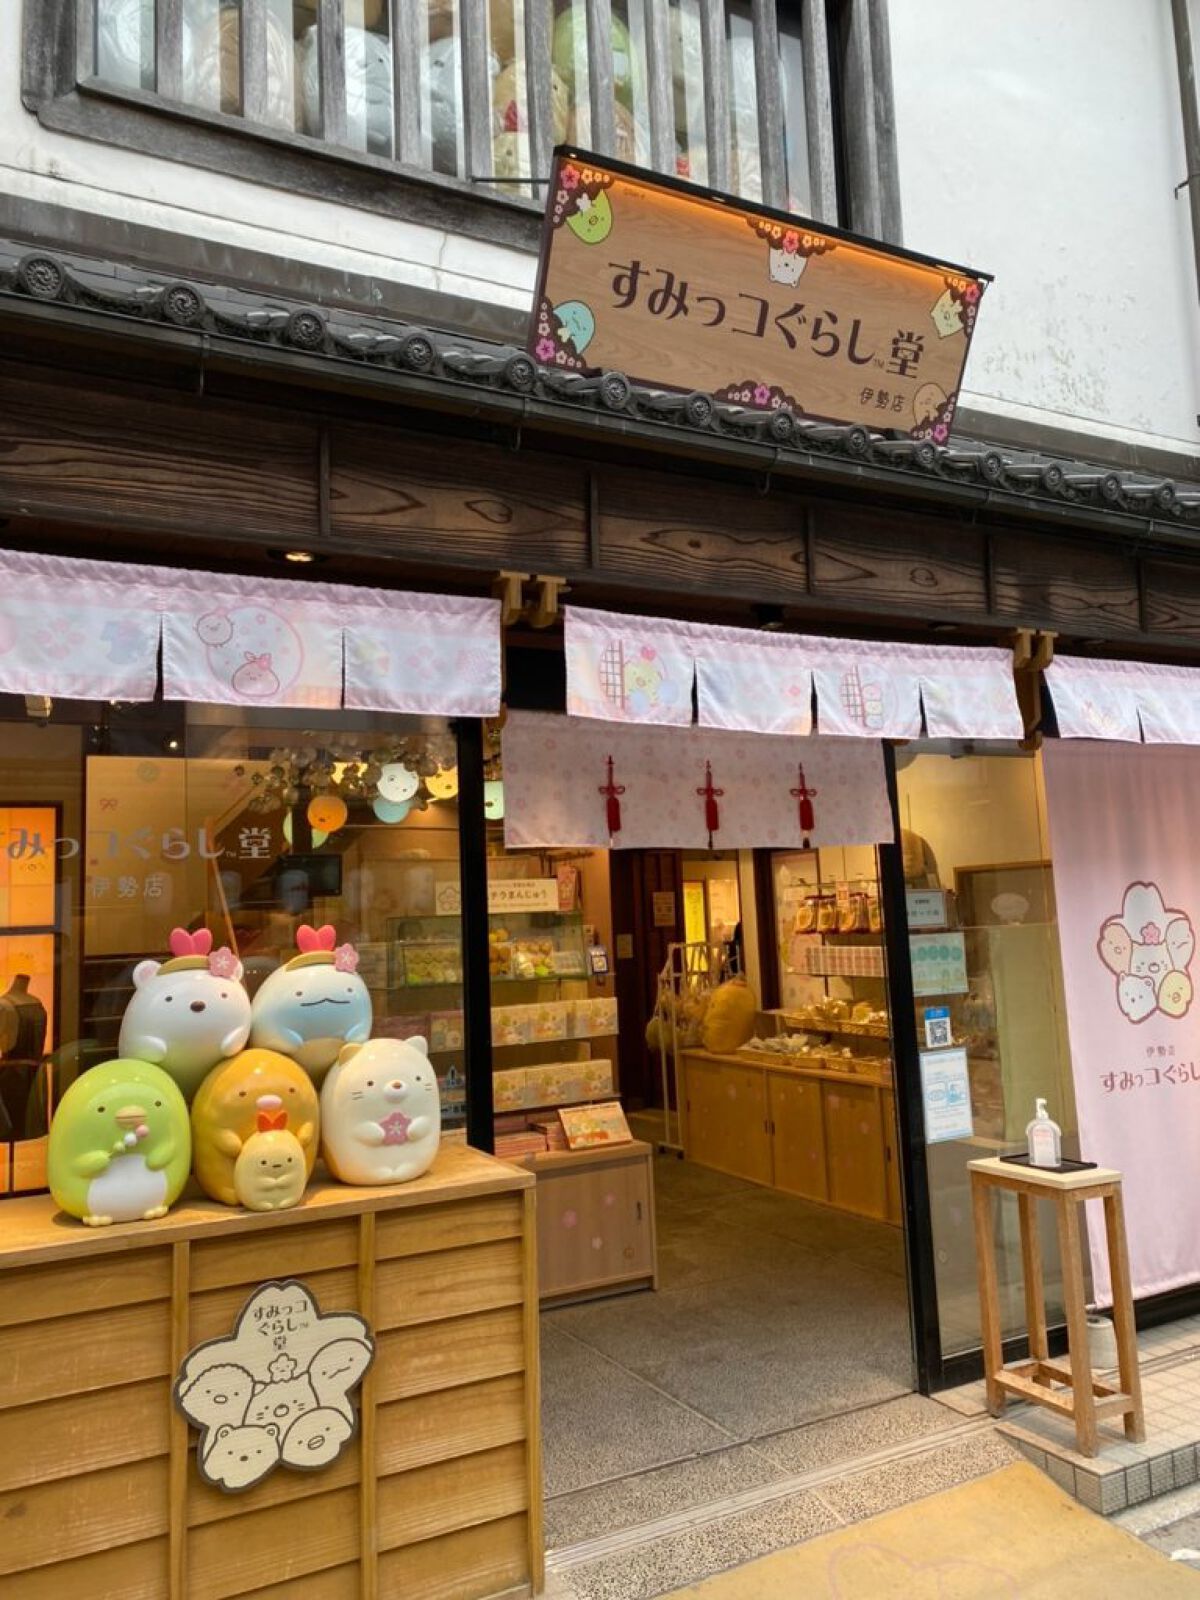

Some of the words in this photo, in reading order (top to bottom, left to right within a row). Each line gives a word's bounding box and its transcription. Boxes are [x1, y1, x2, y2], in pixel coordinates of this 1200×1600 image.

[860, 386, 905, 412] 伊勢店
[91, 875, 164, 898] 伊勢店
[253, 1300, 307, 1322] すみっコ
[258, 1318, 297, 1336] ぐらし
